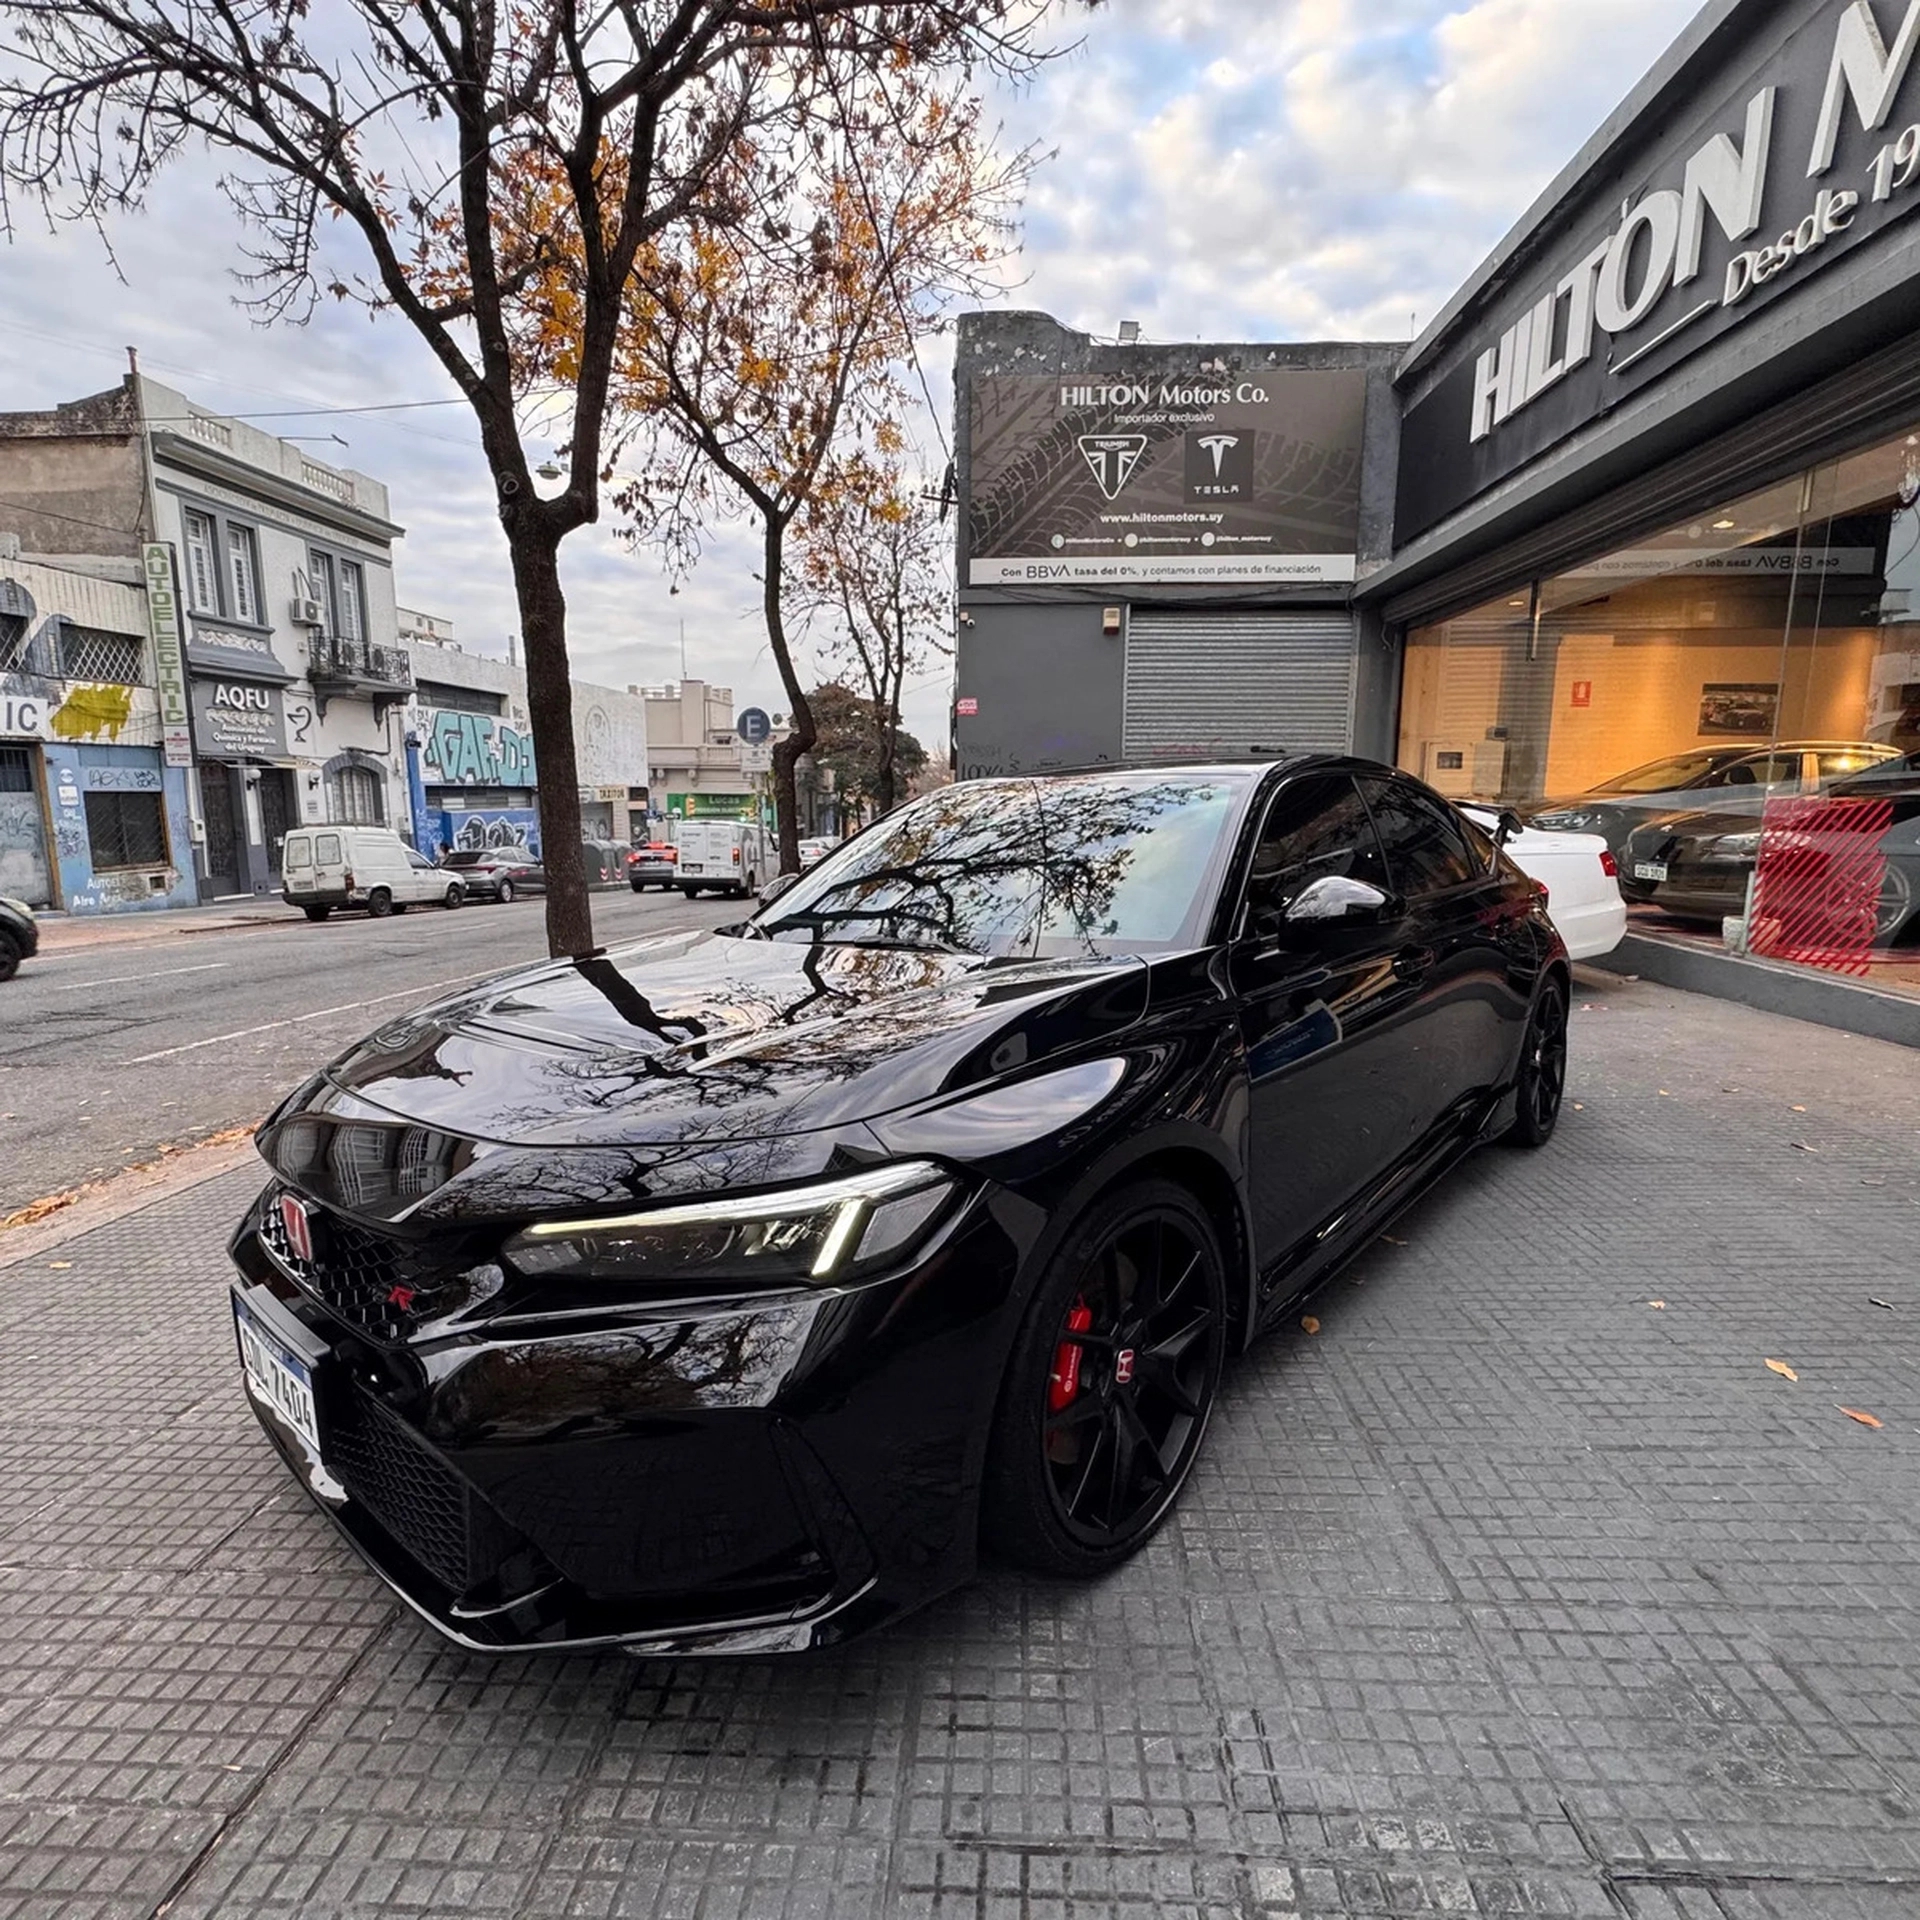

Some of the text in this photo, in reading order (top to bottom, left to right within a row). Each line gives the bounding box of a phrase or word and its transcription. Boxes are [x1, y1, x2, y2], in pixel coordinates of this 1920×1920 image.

[1722, 189, 1859, 306] Desde
[1470, 86, 1776, 443] HILTON
[1061, 383, 1270, 406] HILTON Motors Co.
[1114, 412, 1215, 425] Importador exclusivo
[1194, 485, 1240, 494] TESLA
[1100, 512, 1224, 524] www.hiltonmotors.uy
[1001, 567, 1021, 577] Con
[1026, 564, 1071, 579] BBVA
[1075, 566, 1098, 576] tasa
[1100, 565, 1118, 576] del
[1150, 565, 1195, 575] contamos
[1198, 566, 1216, 574] con
[1217, 565, 1248, 576] planes
[1251, 564, 1263, 574] de
[1265, 563, 1321, 574] financiación
[146, 547, 184, 723] AUTOELECTRIC
[214, 683, 270, 710] AQFU
[745, 715, 763, 737] E
[270, 1358, 314, 1438] 7404
